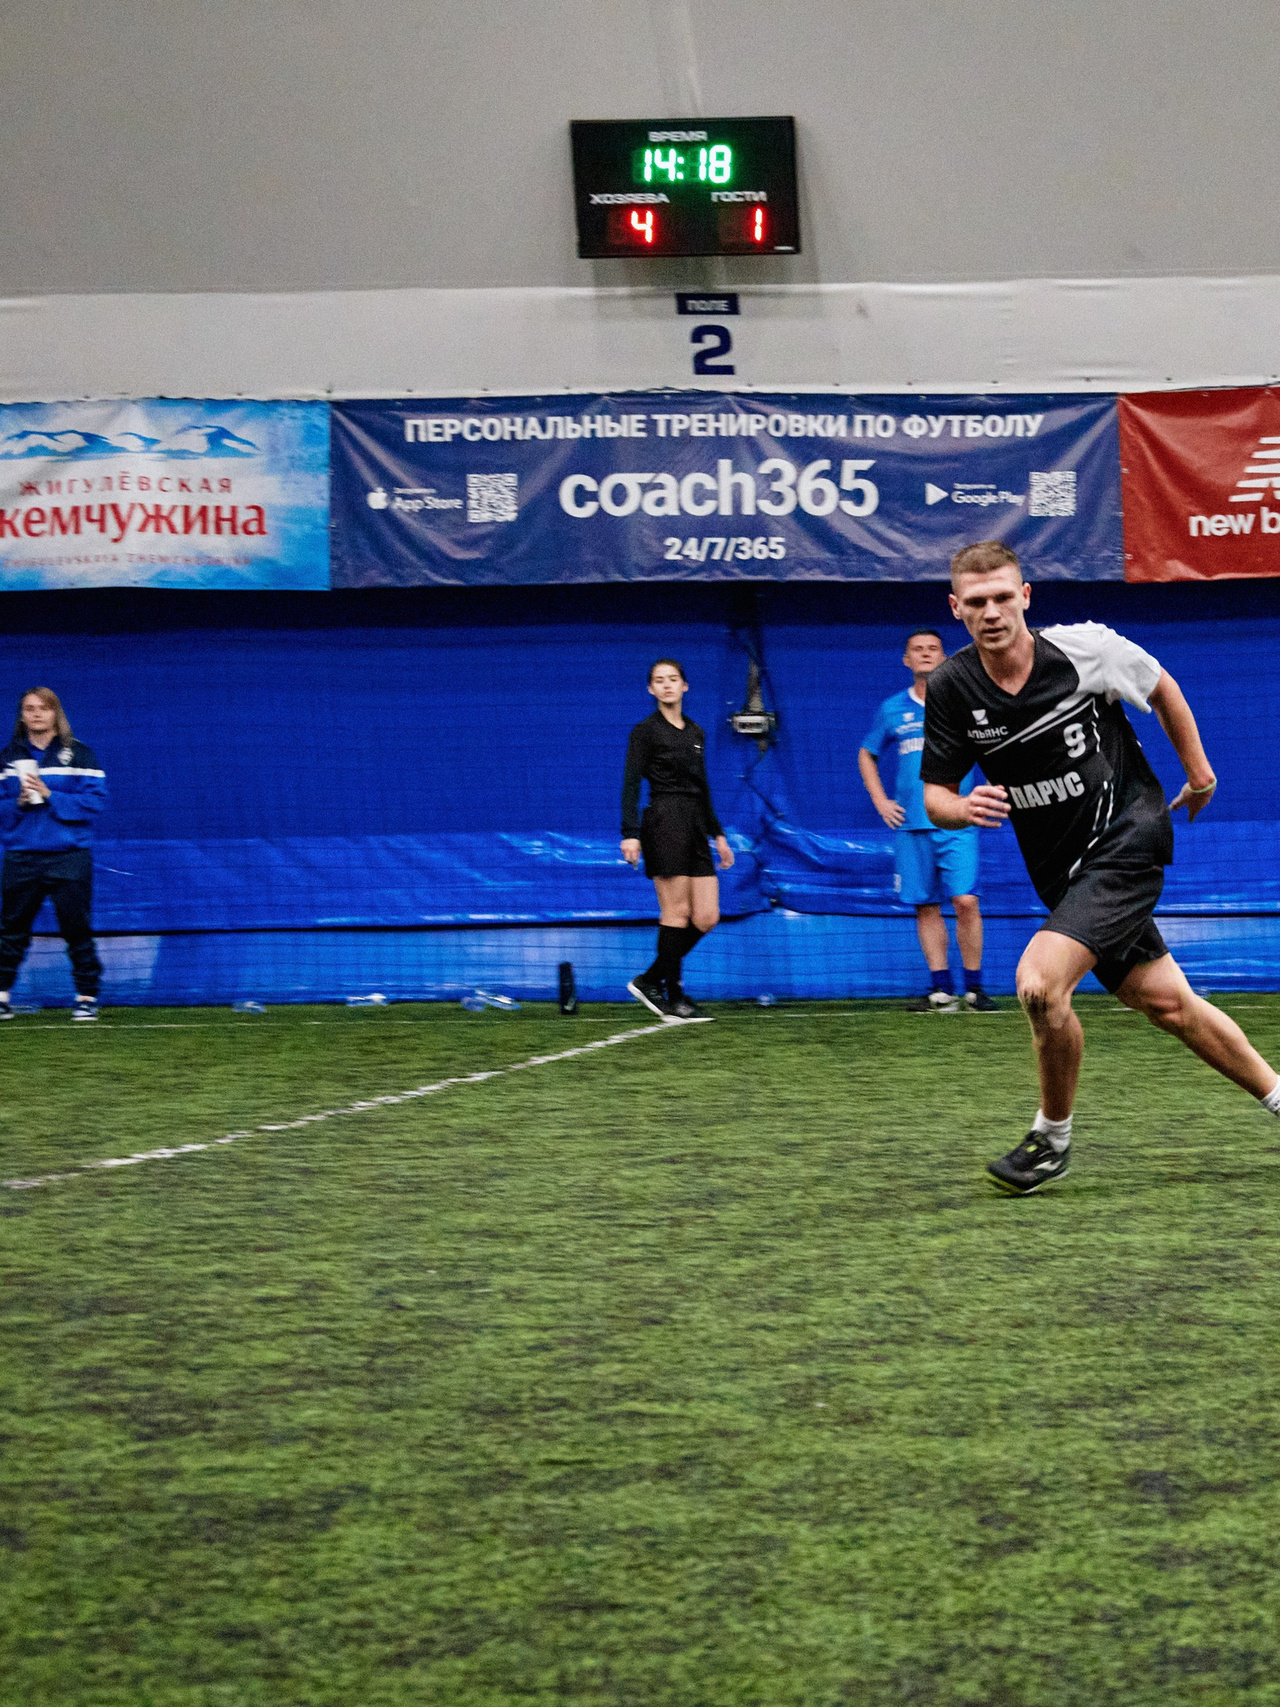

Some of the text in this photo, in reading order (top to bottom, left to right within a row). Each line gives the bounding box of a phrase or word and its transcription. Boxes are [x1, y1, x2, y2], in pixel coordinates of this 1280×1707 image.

[648, 131, 708, 142] ВРЕМЯ
[644, 144, 732, 184] 14:18
[711, 191, 768, 202] ГОСТИ
[630, 210, 653, 243] 4
[753, 208, 764, 241] 1
[686, 299, 731, 312] ПОЛЕ
[690, 323, 736, 376] 2
[404, 413, 1044, 443] ПЕРСОНАЛЬНЫЕ ТРЕНИРОВКИ ПО ФУТБОЛУ
[20, 471, 233, 497] ЖИГУЛЁВСКАЯ
[558, 458, 880, 519] coach365
[950, 490, 999, 507] Google
[1188, 511, 1256, 538] new
[663, 536, 787, 563] 24/7/365
[1062, 722, 1087, 759] 9
[1009, 770, 1086, 810] ПАРУС
